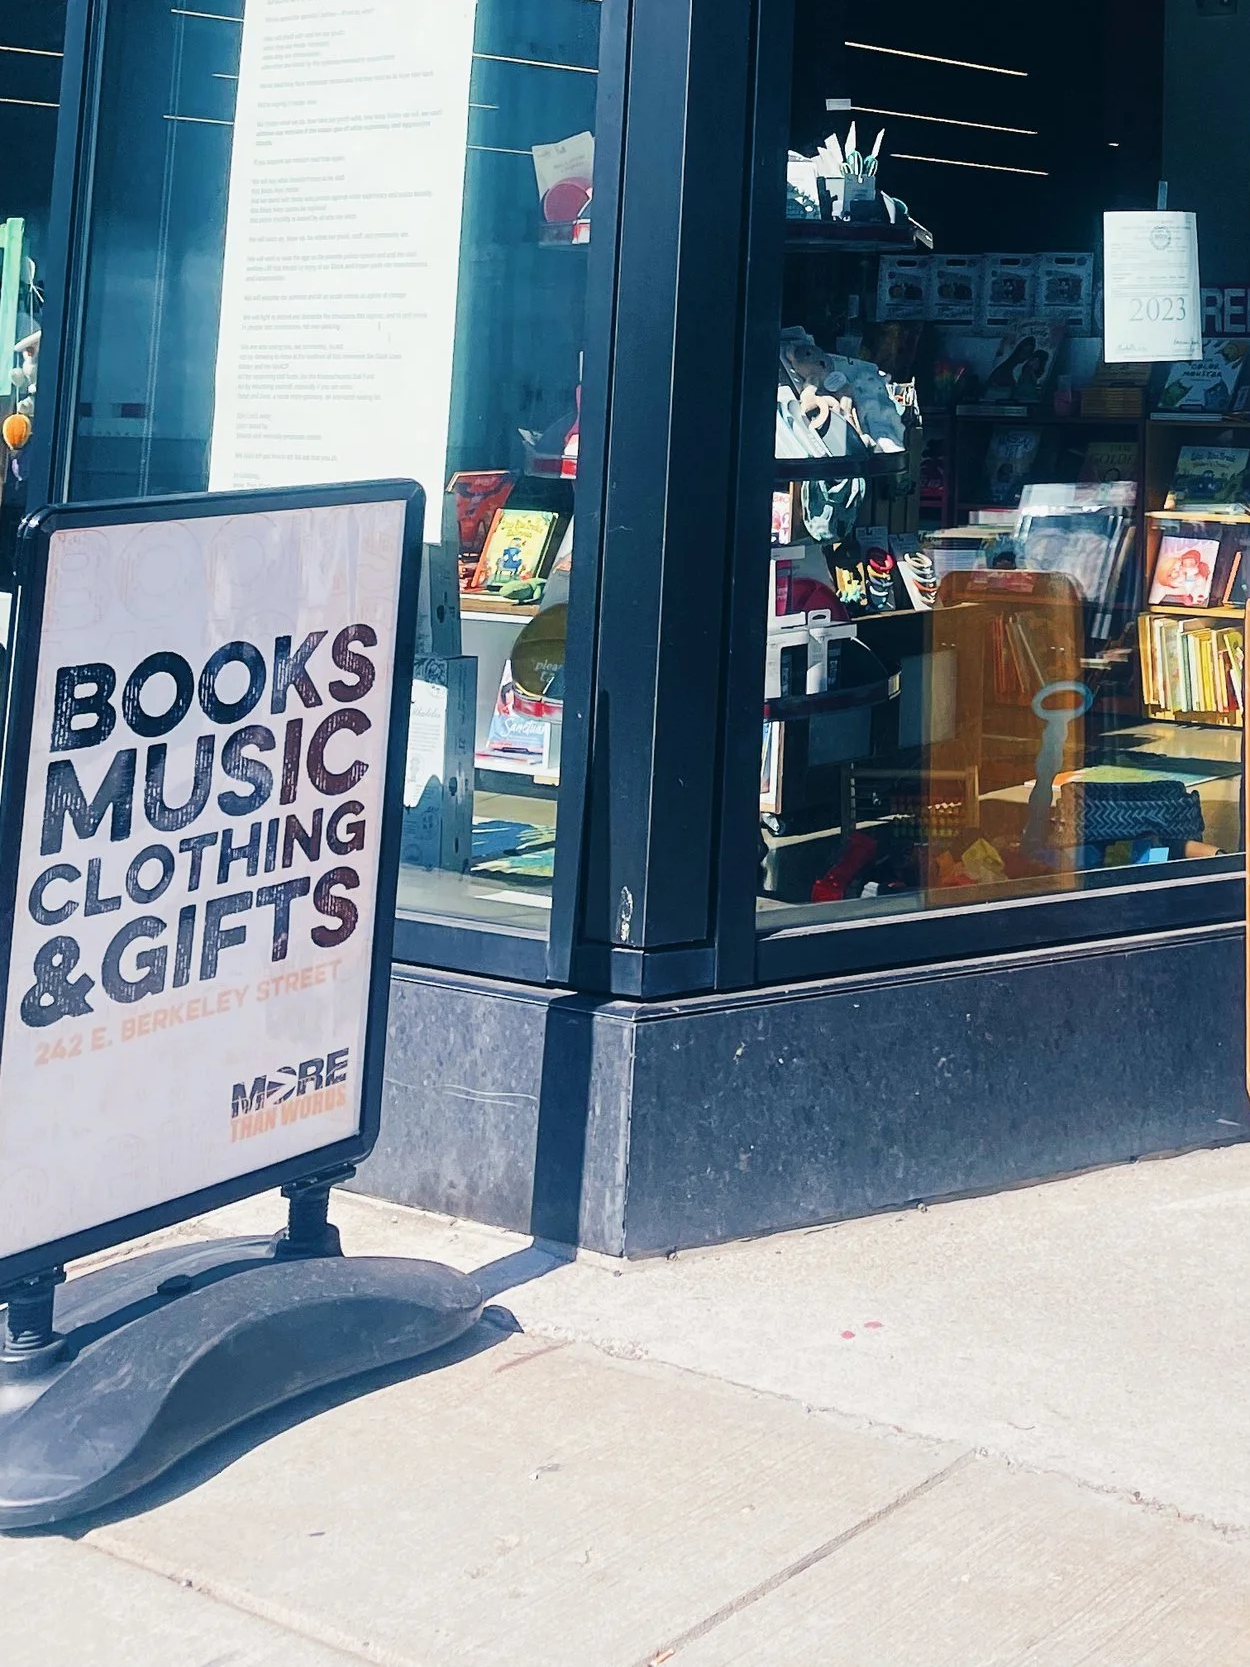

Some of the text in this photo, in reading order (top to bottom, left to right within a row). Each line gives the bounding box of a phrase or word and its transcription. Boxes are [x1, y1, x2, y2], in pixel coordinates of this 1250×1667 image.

[1128, 297, 1186, 321] 2023
[49, 623, 379, 752] BOOKS
[39, 708, 370, 856] MUSIC
[28, 800, 366, 927] CLOTHING
[33, 959, 342, 1067] 242 E. BERKELEY STREET
[230, 1084, 348, 1143] THAN WORDS
